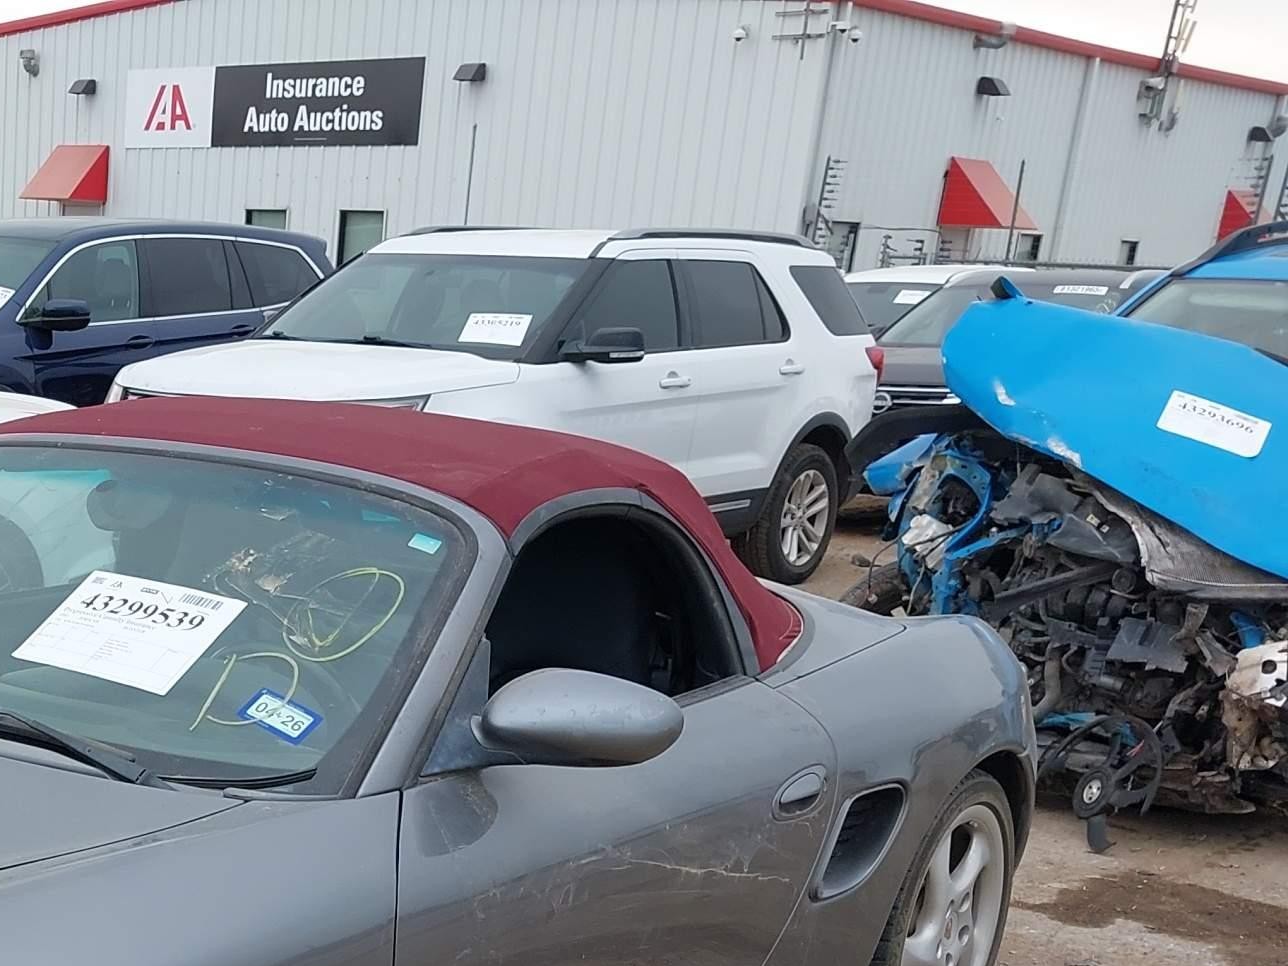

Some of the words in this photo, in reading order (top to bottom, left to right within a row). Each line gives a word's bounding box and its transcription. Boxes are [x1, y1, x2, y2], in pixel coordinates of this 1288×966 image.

[265, 71, 365, 99] Insurance
[243, 105, 289, 133] Auto
[293, 104, 384, 132] Auctions
[80, 593, 206, 631] 43299539
